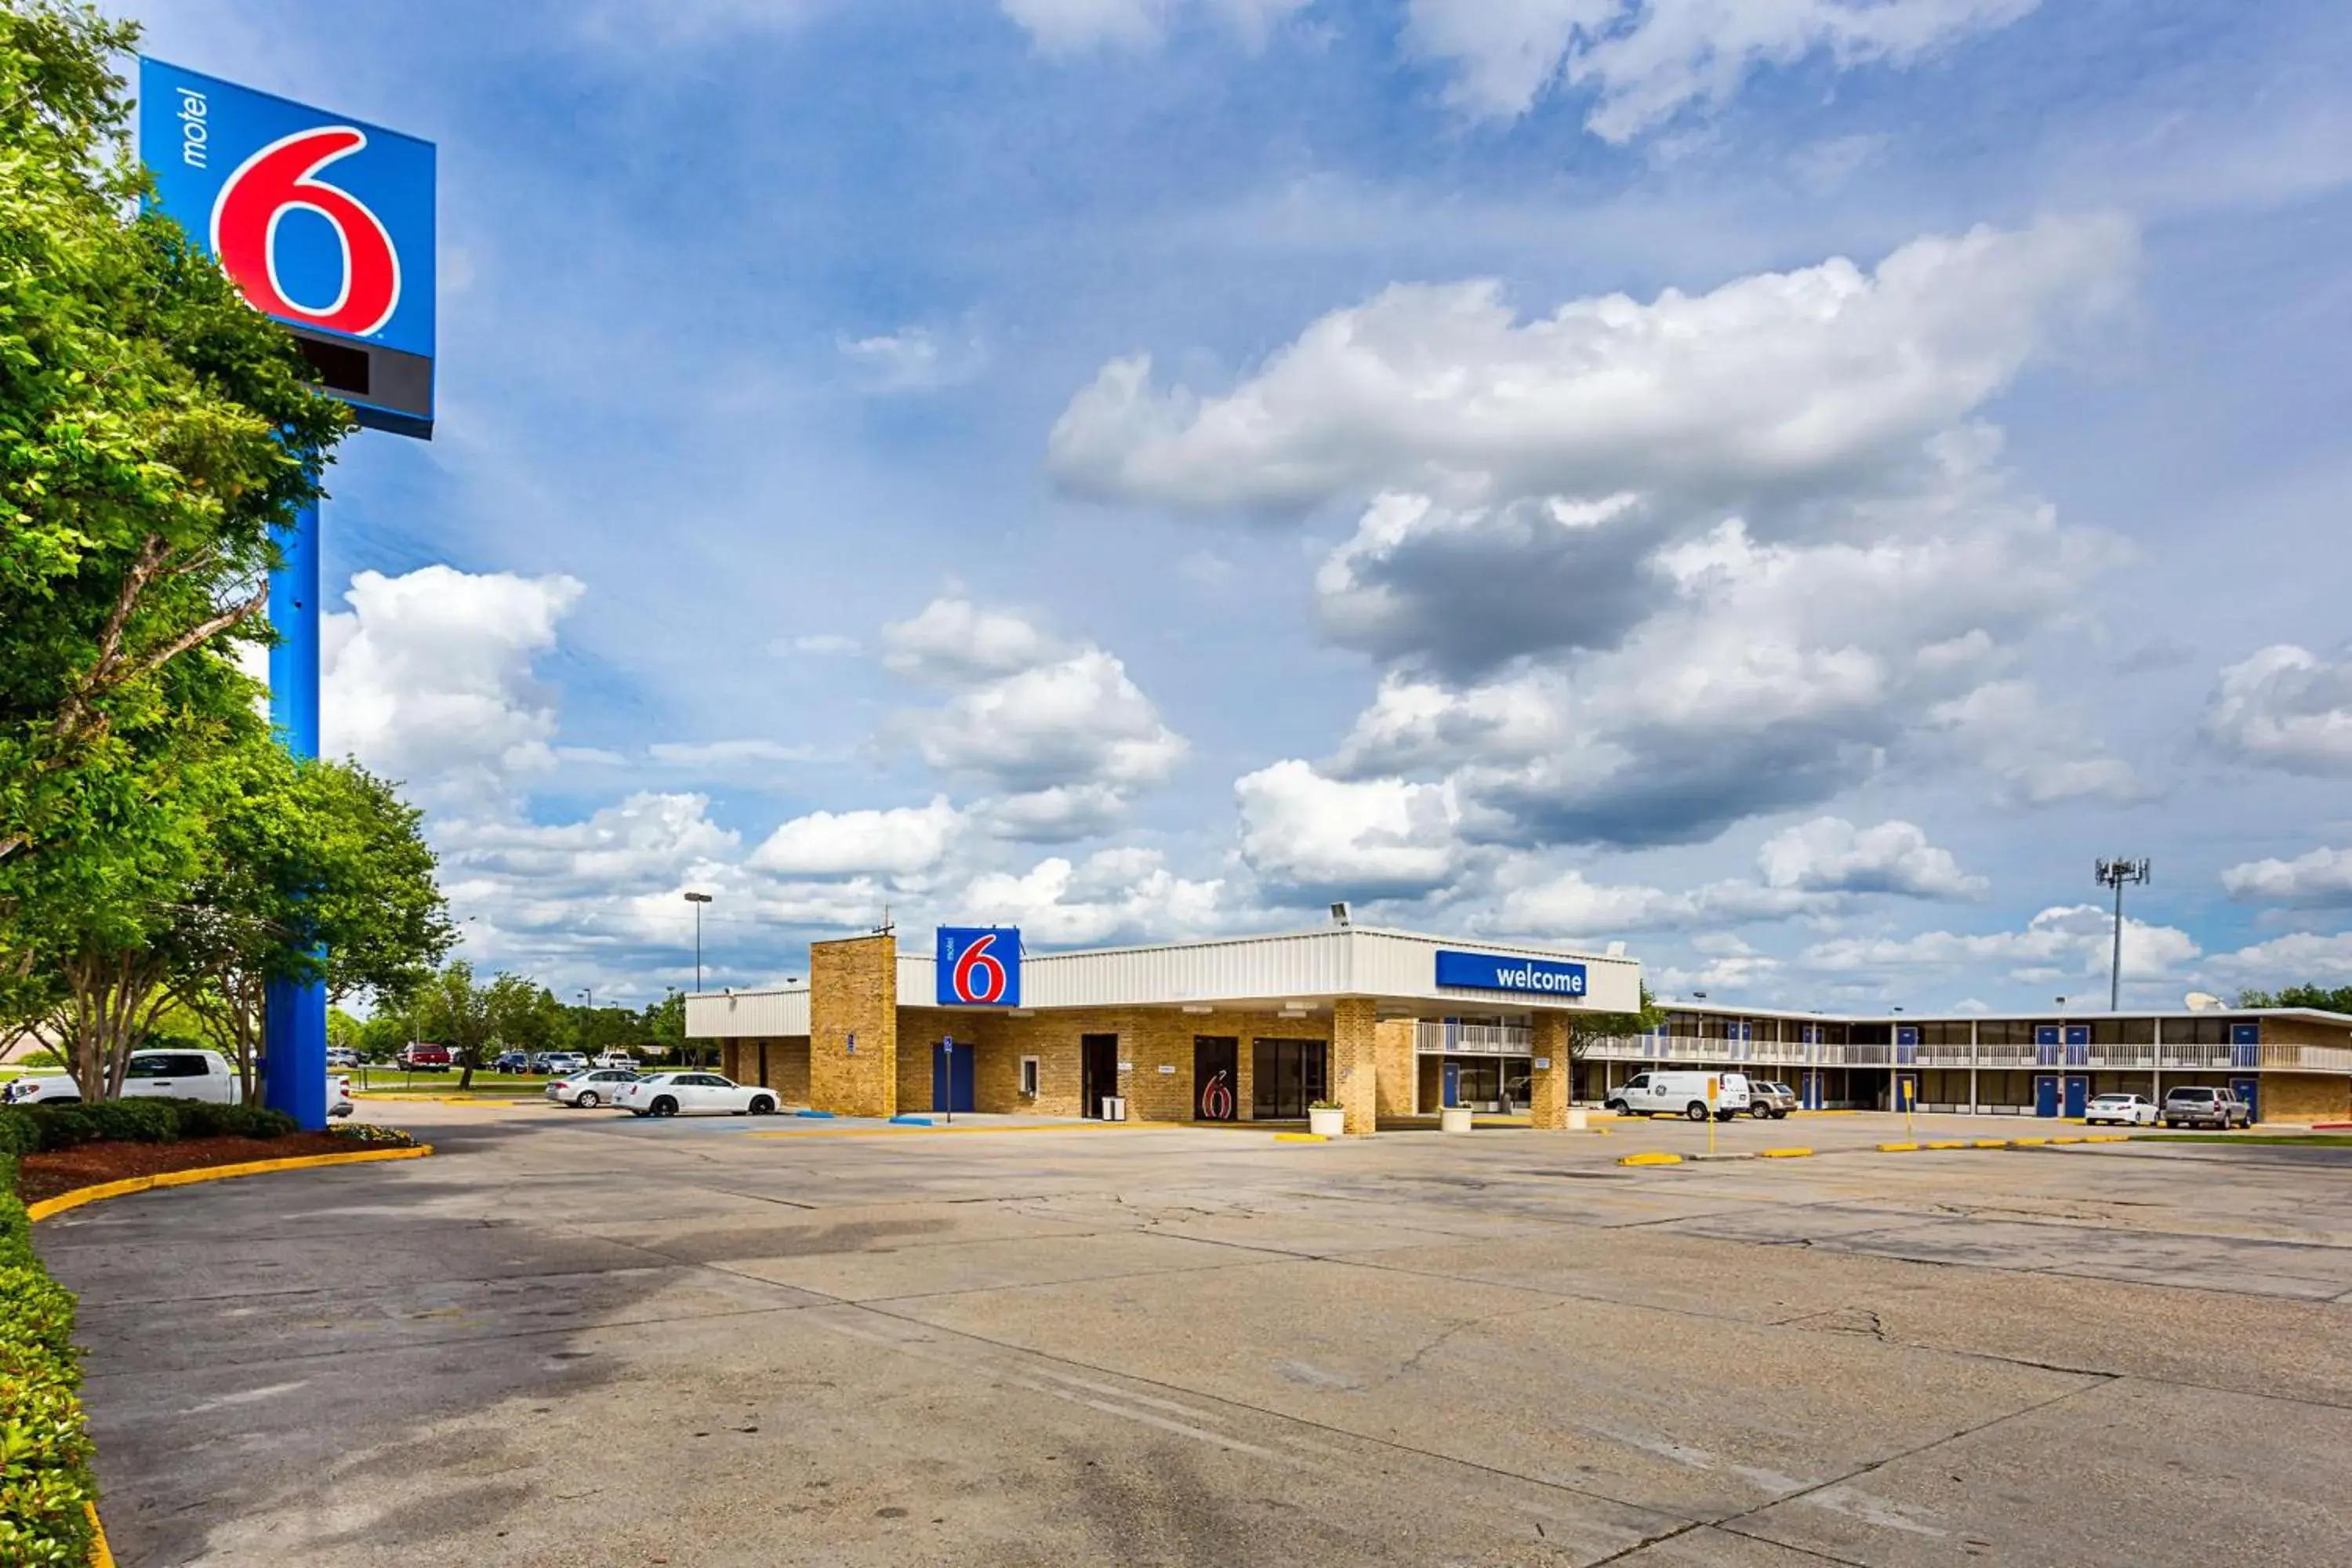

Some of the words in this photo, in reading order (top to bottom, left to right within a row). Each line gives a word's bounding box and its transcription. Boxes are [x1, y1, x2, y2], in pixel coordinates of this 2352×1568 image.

[176, 87, 207, 169] motel
[209, 125, 401, 337] 6
[953, 934, 1007, 1003] 6
[1496, 962, 1582, 992] welcome
